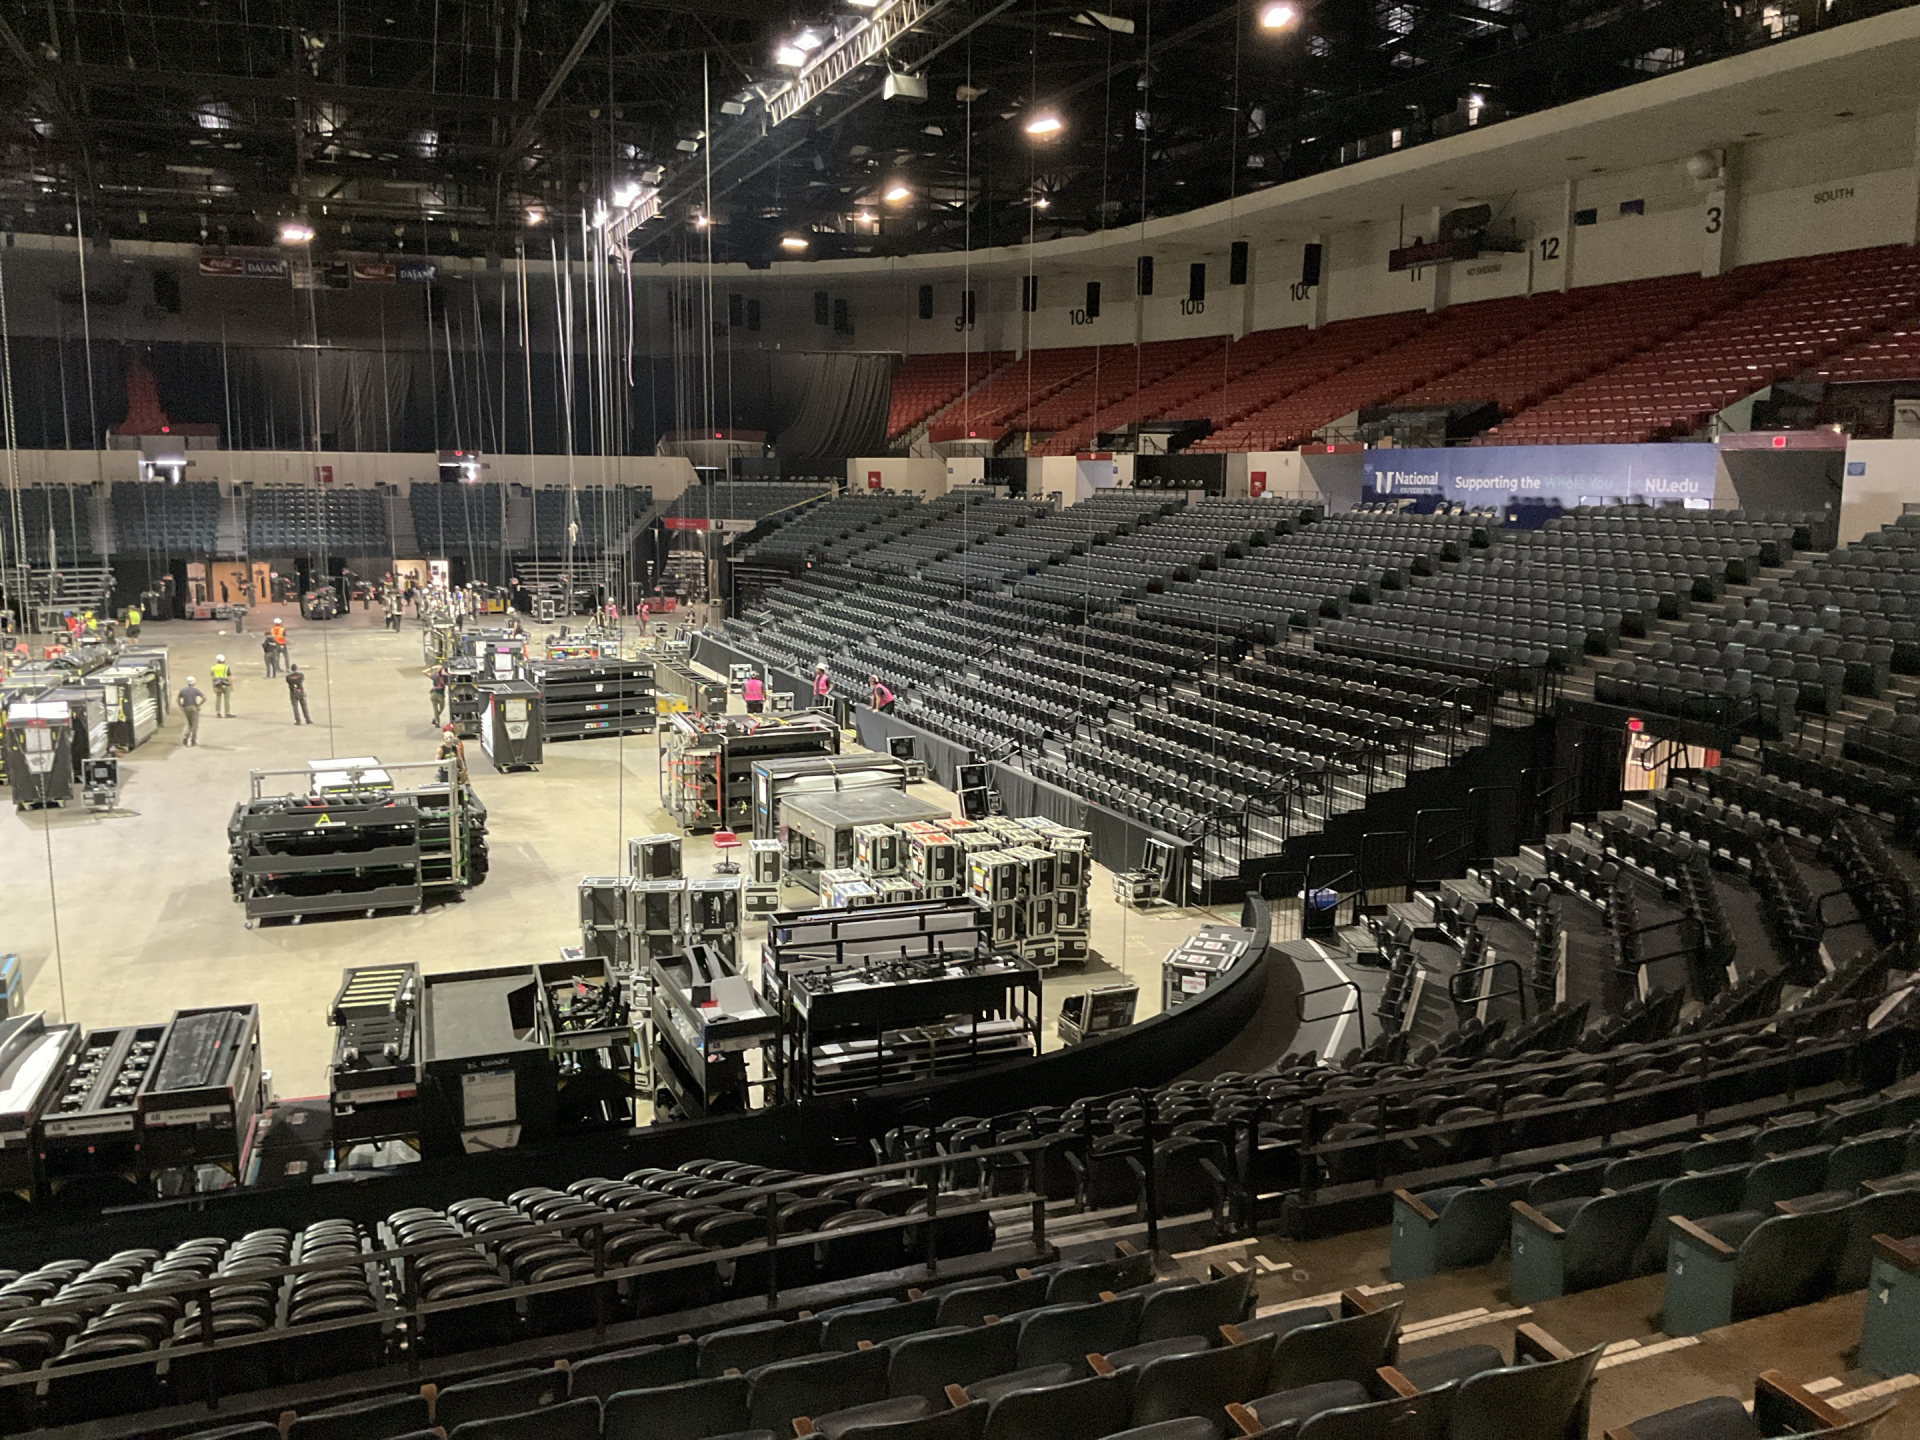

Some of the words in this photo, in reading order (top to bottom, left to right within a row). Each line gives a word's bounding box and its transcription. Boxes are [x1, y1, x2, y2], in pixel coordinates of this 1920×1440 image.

[1813, 187, 1854, 204] SOUTH
[1705, 206, 1722, 234] 3
[1540, 237, 1560, 261] 12
[1395, 471, 1439, 485] National
[1455, 475, 1518, 492] Supporting
[1520, 476, 1541, 489] the
[1645, 478, 1699, 493] NU.edu
